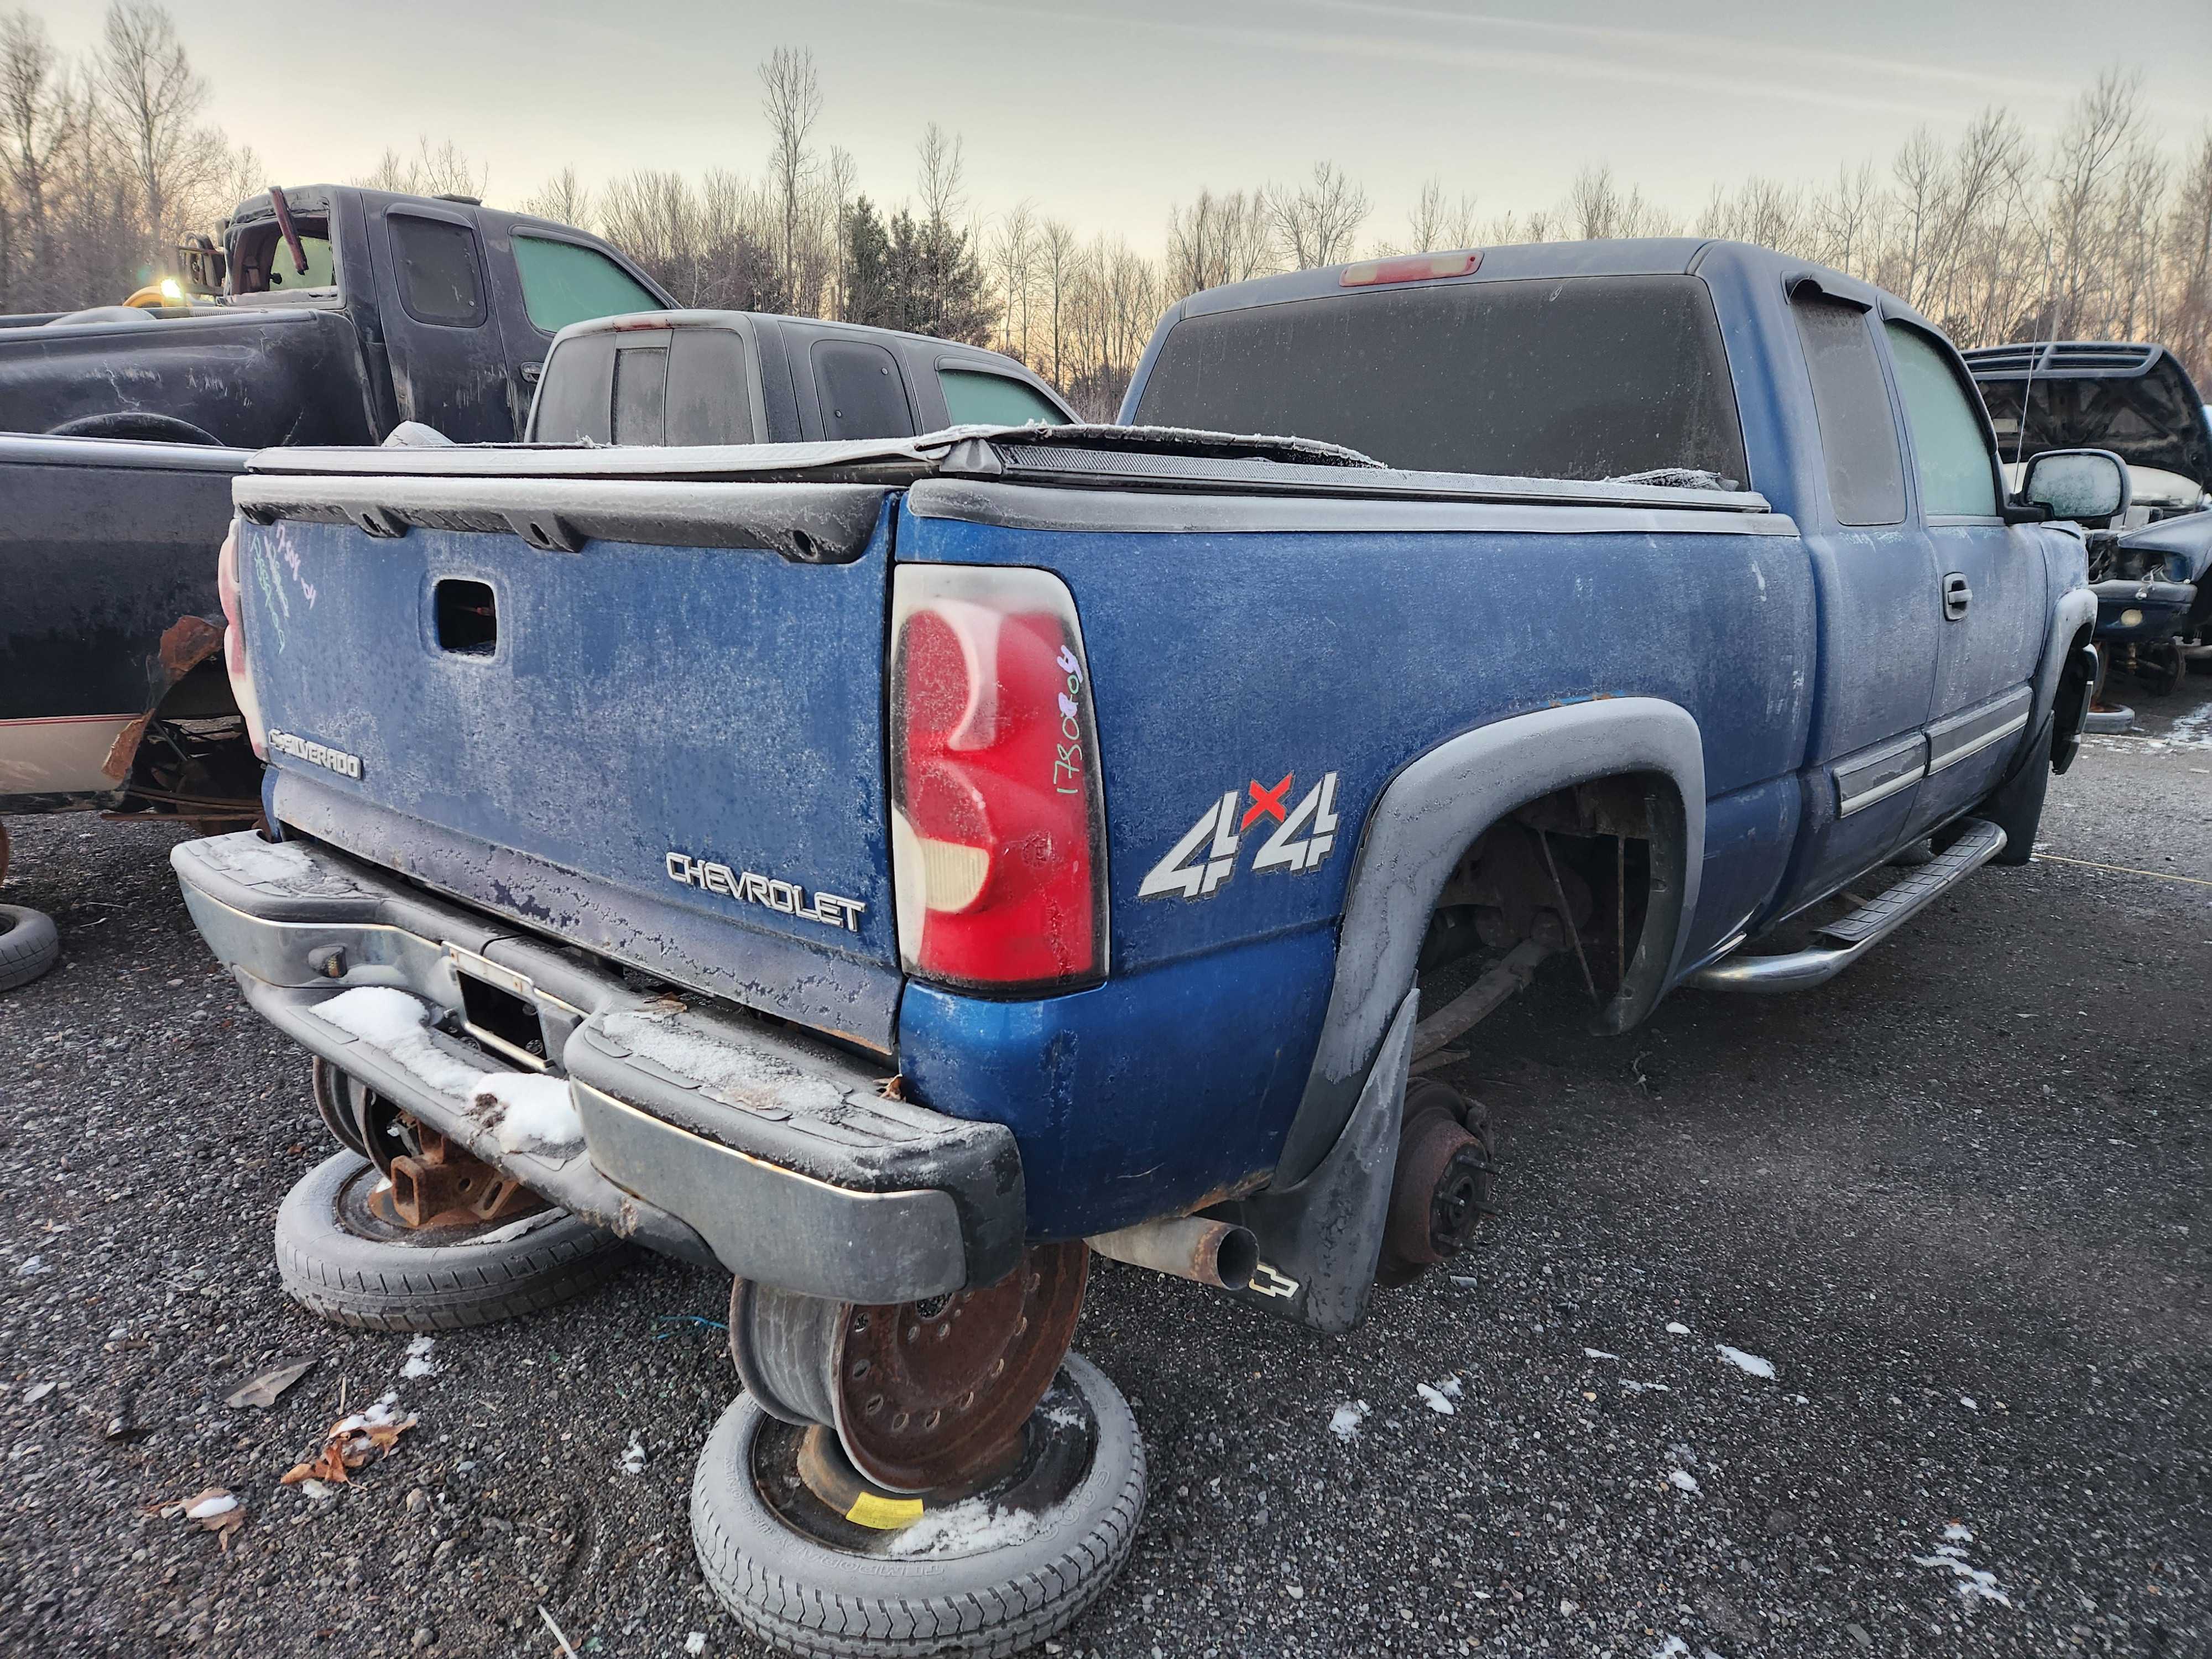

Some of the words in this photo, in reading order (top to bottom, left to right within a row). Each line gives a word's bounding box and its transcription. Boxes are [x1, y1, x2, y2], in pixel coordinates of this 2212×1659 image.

[283, 733, 361, 778] SILVERADO
[666, 852, 867, 931] CHEVROLET
[725, 1457, 744, 1502] ONLY
[739, 1505, 775, 1536] USE
[778, 1538, 945, 1577] TEMPORARY
